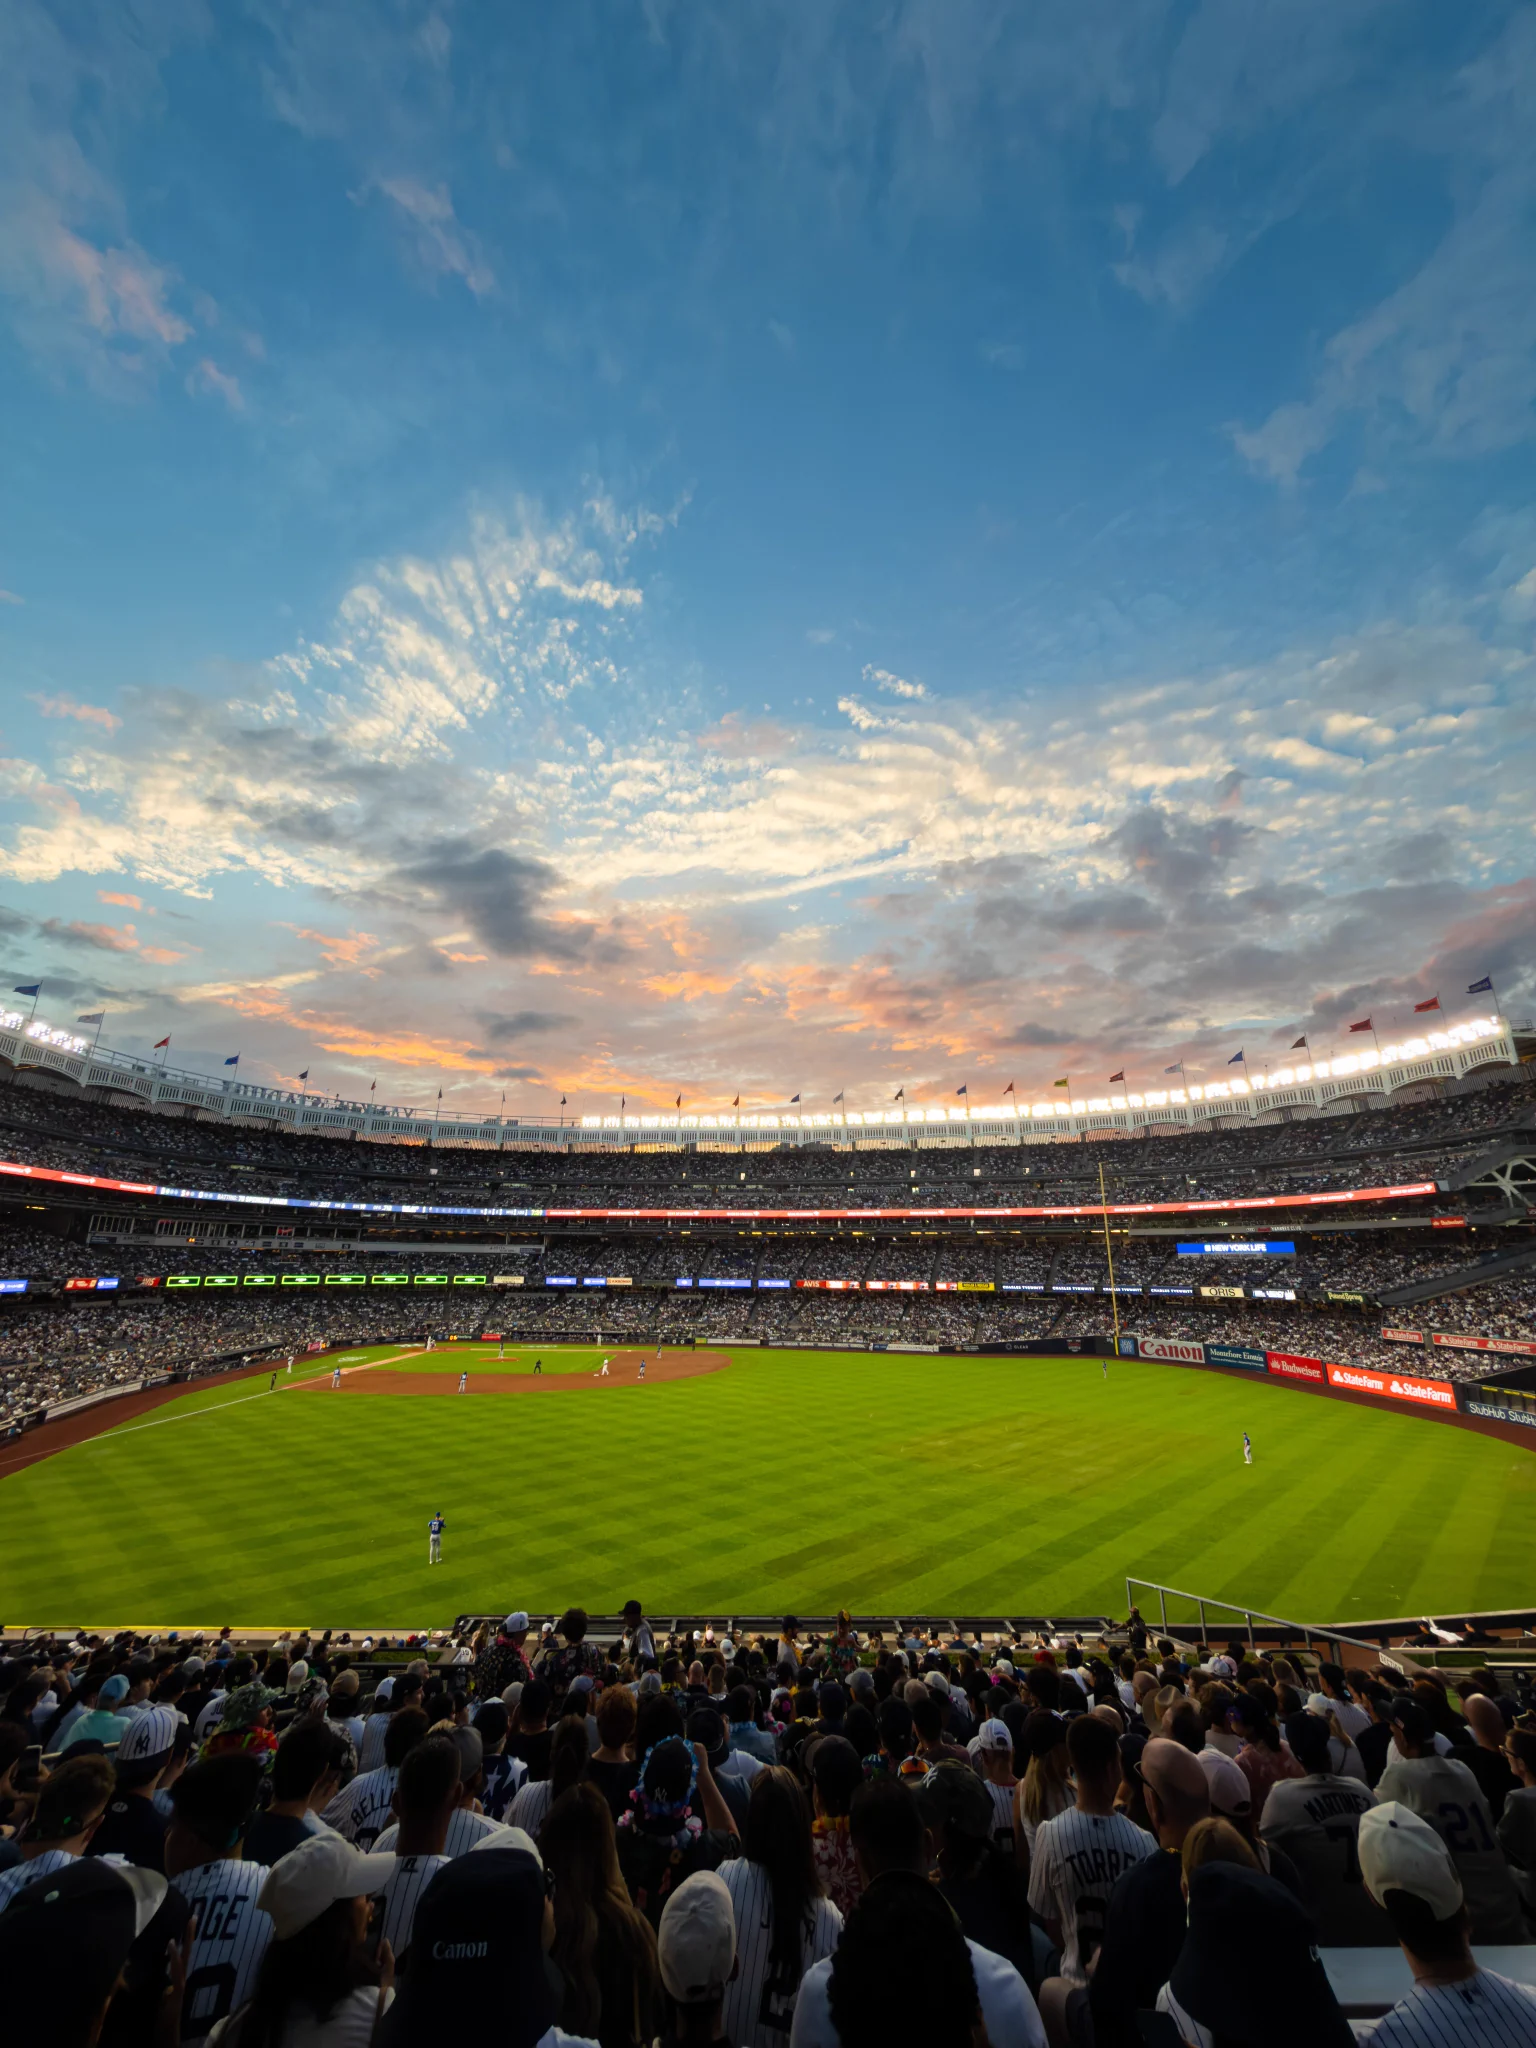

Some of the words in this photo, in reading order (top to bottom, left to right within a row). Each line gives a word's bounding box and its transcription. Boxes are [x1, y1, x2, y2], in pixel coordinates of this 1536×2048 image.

[1212, 1244, 1229, 1252] NEW
[1229, 1244, 1250, 1252] YORK
[1250, 1243, 1267, 1251] LIFE
[1209, 1288, 1236, 1297] ORIS
[1139, 1340, 1203, 1361] Canon
[1210, 1348, 1242, 1359] Montefiore
[1243, 1352, 1264, 1362] Einstein
[1281, 1361, 1320, 1378] Budweiser
[1469, 1404, 1506, 1419] StubHub
[134, 1733, 150, 1755] NY
[1439, 1801, 1495, 1852] 21
[432, 1940, 489, 1961] Canon
